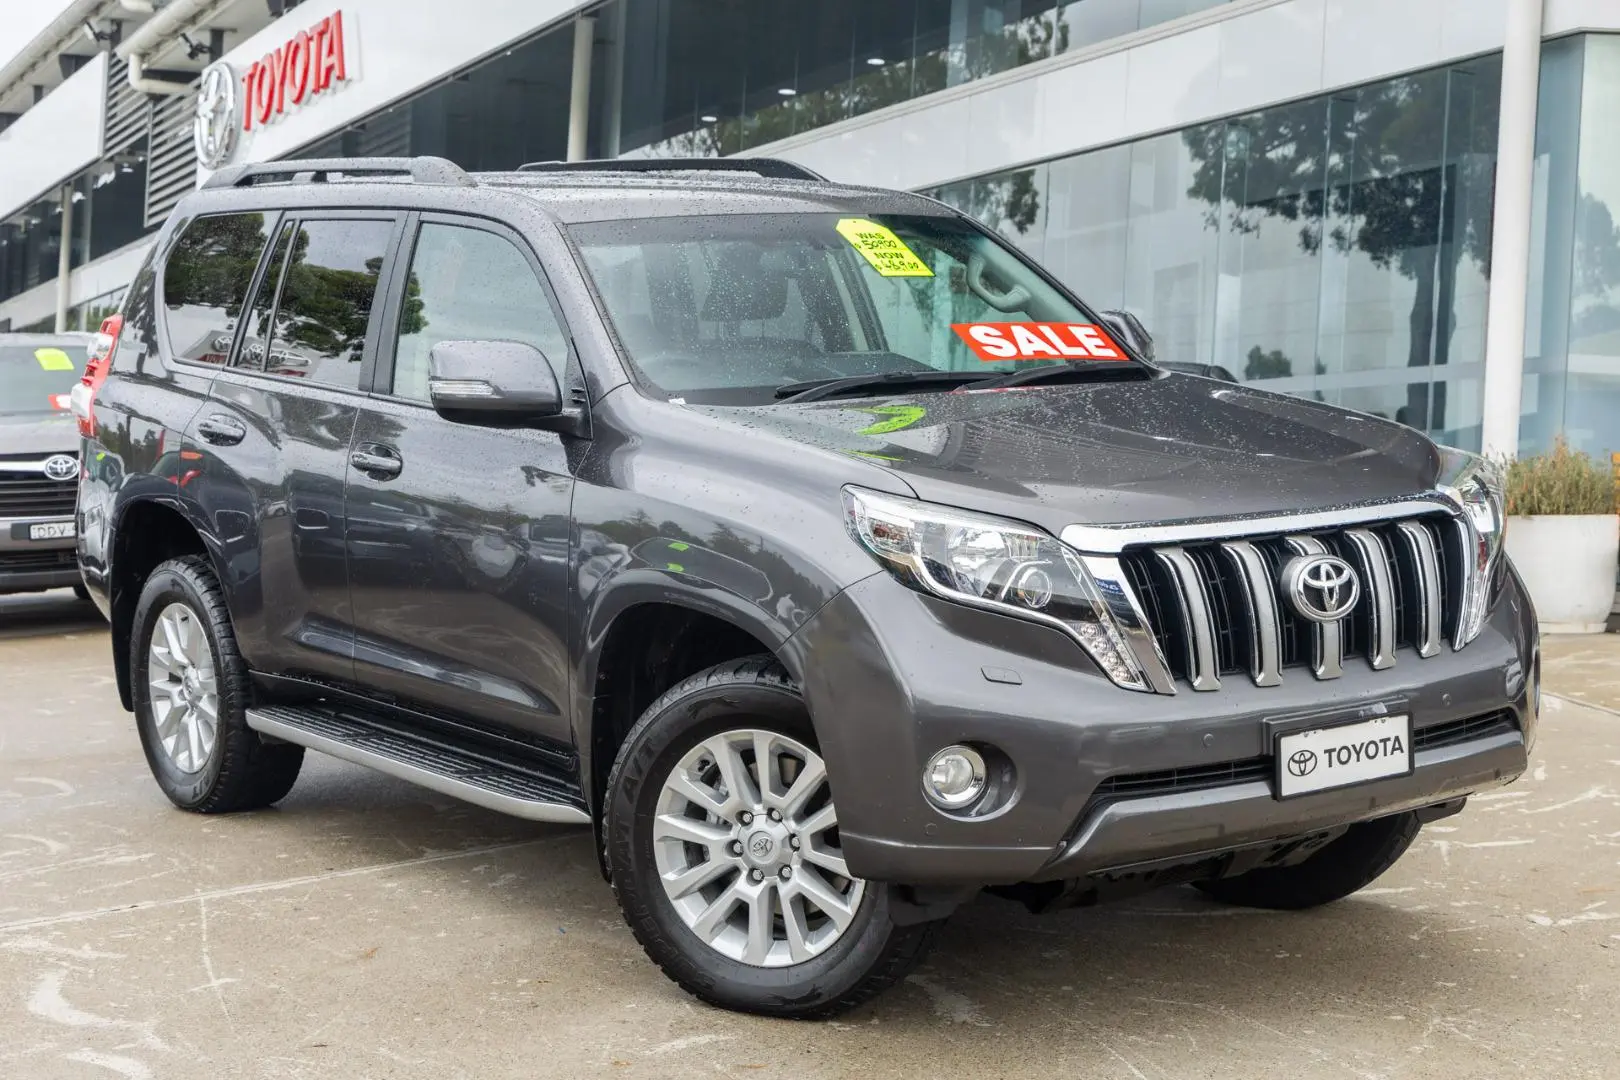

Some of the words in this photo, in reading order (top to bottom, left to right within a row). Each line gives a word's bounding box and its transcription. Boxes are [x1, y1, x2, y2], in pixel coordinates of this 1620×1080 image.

[241, 9, 346, 132] TOYOTA
[968, 325, 1118, 358] SALE
[1324, 735, 1404, 767] TOYOTA
